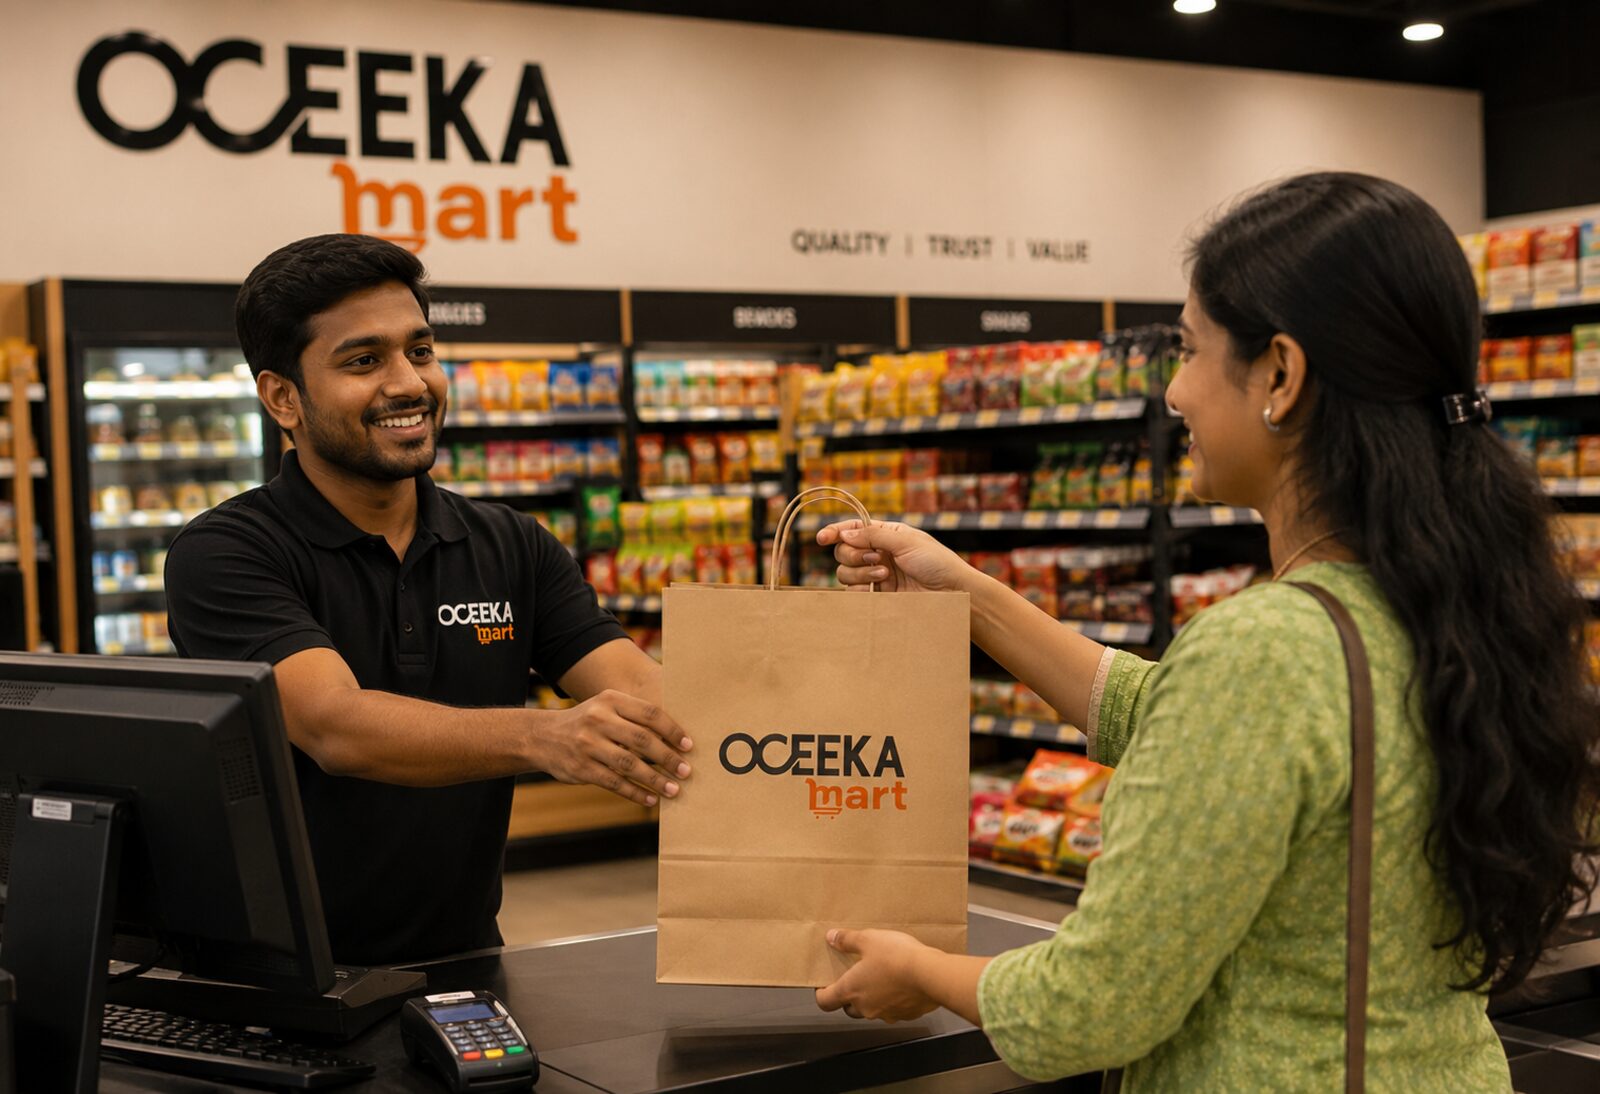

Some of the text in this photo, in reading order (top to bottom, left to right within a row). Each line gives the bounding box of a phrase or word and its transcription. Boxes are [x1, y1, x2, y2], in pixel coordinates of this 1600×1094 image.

[76, 30, 572, 168] OCEEKA
[330, 158, 579, 254] mart
[791, 228, 1091, 263] QUALITY TRUST VALUE
[437, 601, 514, 626] OCEEKA
[474, 623, 515, 644] mart
[719, 732, 905, 778] OCEEKA
[805, 778, 908, 818] mart
